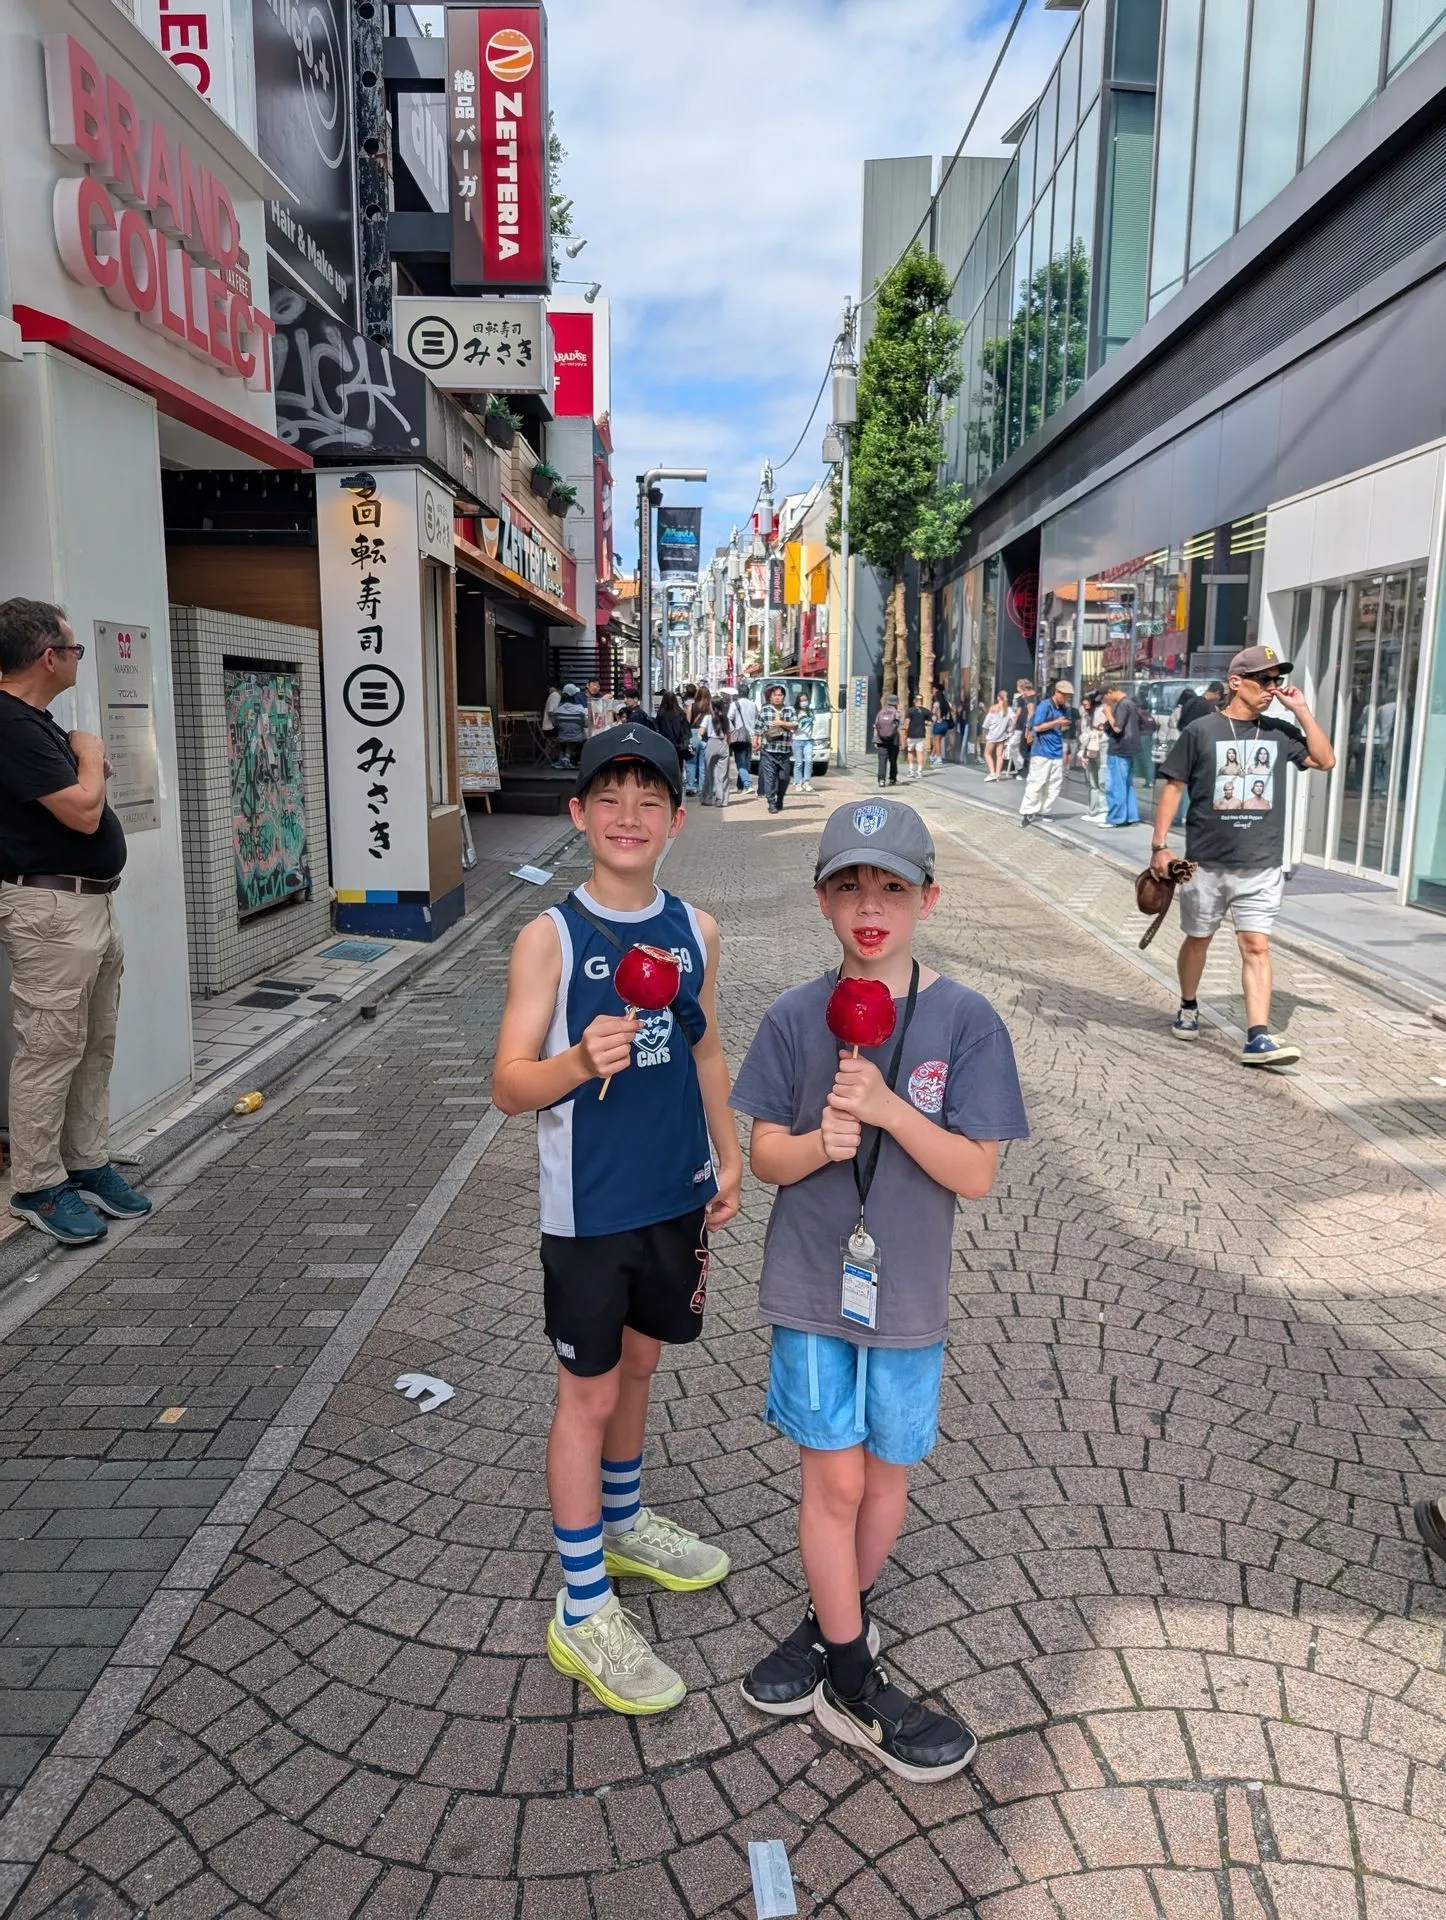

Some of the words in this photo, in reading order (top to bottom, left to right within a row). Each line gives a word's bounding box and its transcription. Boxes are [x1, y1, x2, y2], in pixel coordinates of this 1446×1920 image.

[68, 34, 240, 270] BRAND
[454, 69, 478, 222] 絶品バーガー
[495, 91, 523, 261] ZETTERIA
[78, 176, 276, 393] COLLECT
[271, 200, 296, 244] Hair
[297, 224, 306, 257] &
[307, 233, 334, 286] Make
[334, 270, 347, 304] up
[463, 337, 532, 367] みさき
[472, 320, 522, 339] 回転寿司
[350, 499, 387, 655] 回転寿司
[114, 664, 138, 675] MARRON
[1264, 647, 1275, 660] P
[356, 736, 397, 859] みさき
[584, 956, 610, 980] G
[636, 1046, 671, 1068] CATS
